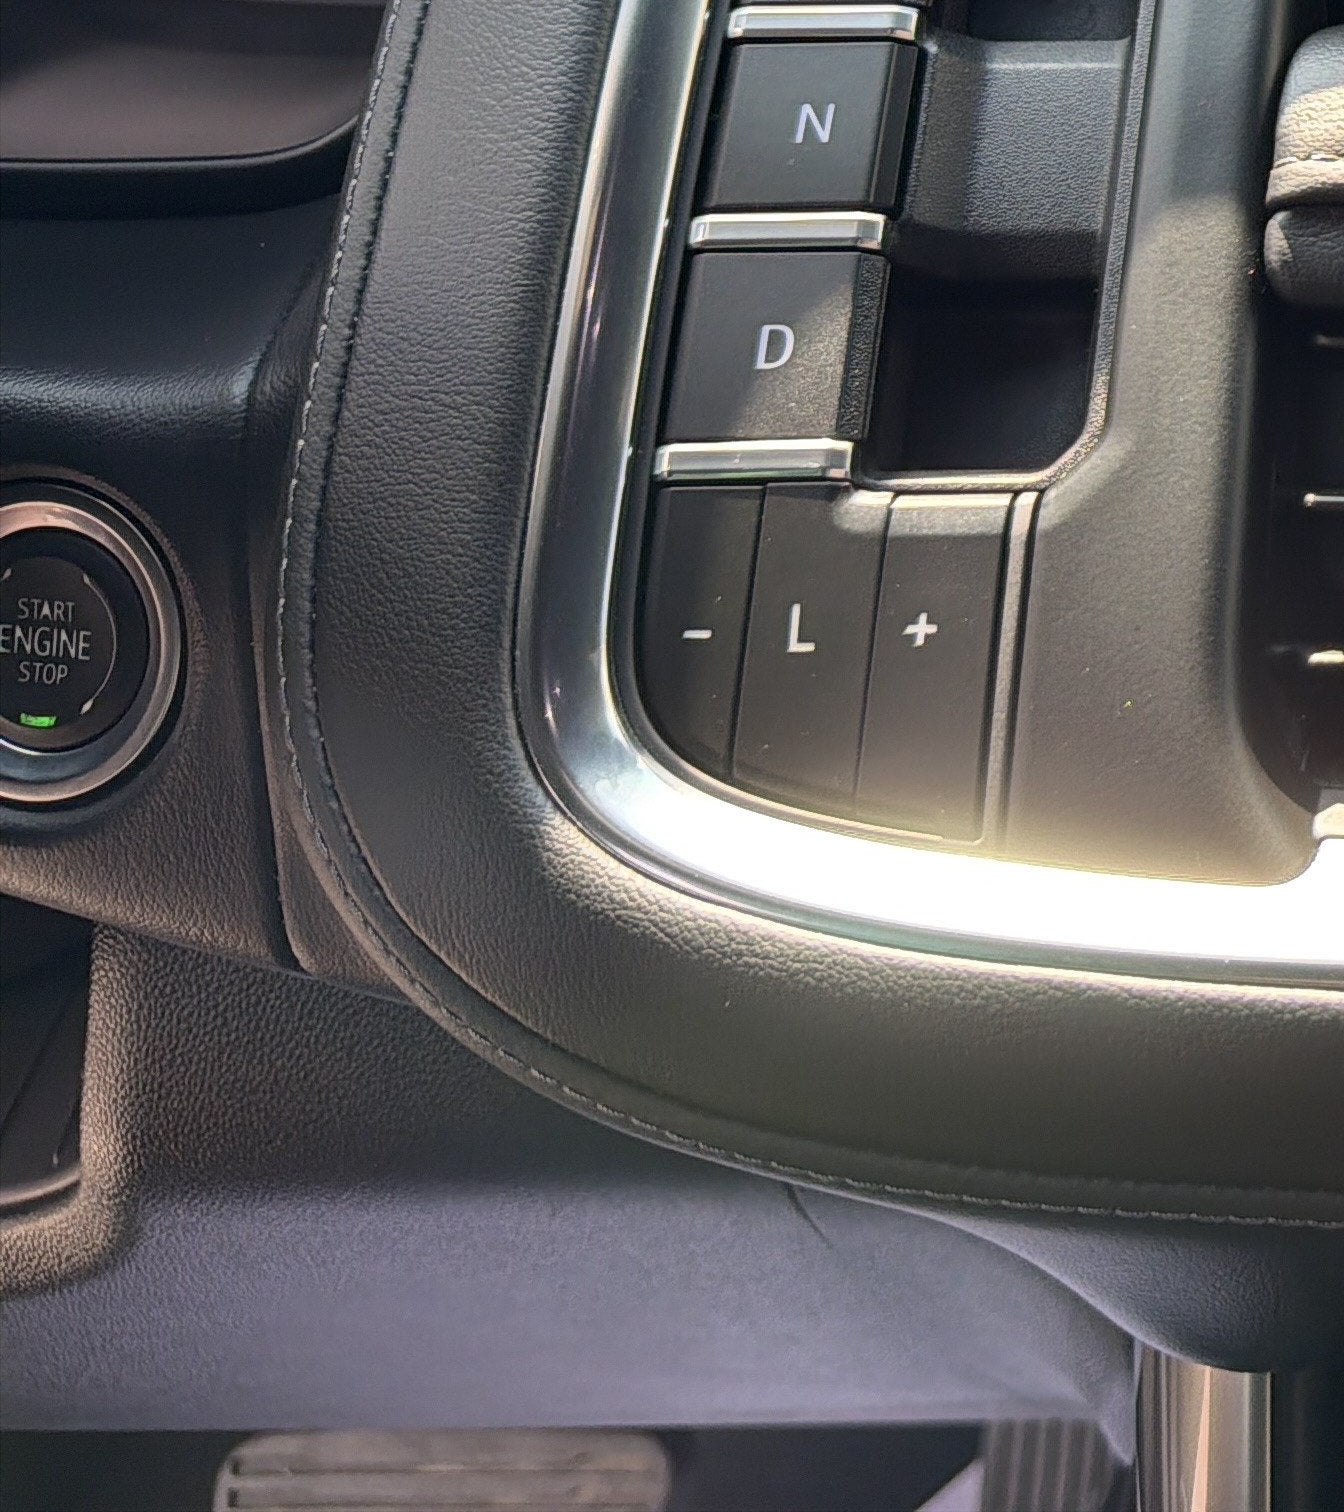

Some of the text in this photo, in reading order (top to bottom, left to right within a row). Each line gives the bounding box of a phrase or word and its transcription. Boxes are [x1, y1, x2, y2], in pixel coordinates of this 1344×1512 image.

[795, 103, 836, 144] N
[754, 323, 796, 370] D
[18, 598, 75, 622] START
[786, 603, 816, 653] L
[0, 625, 92, 661] ENGINE
[18, 661, 68, 685] STOP
